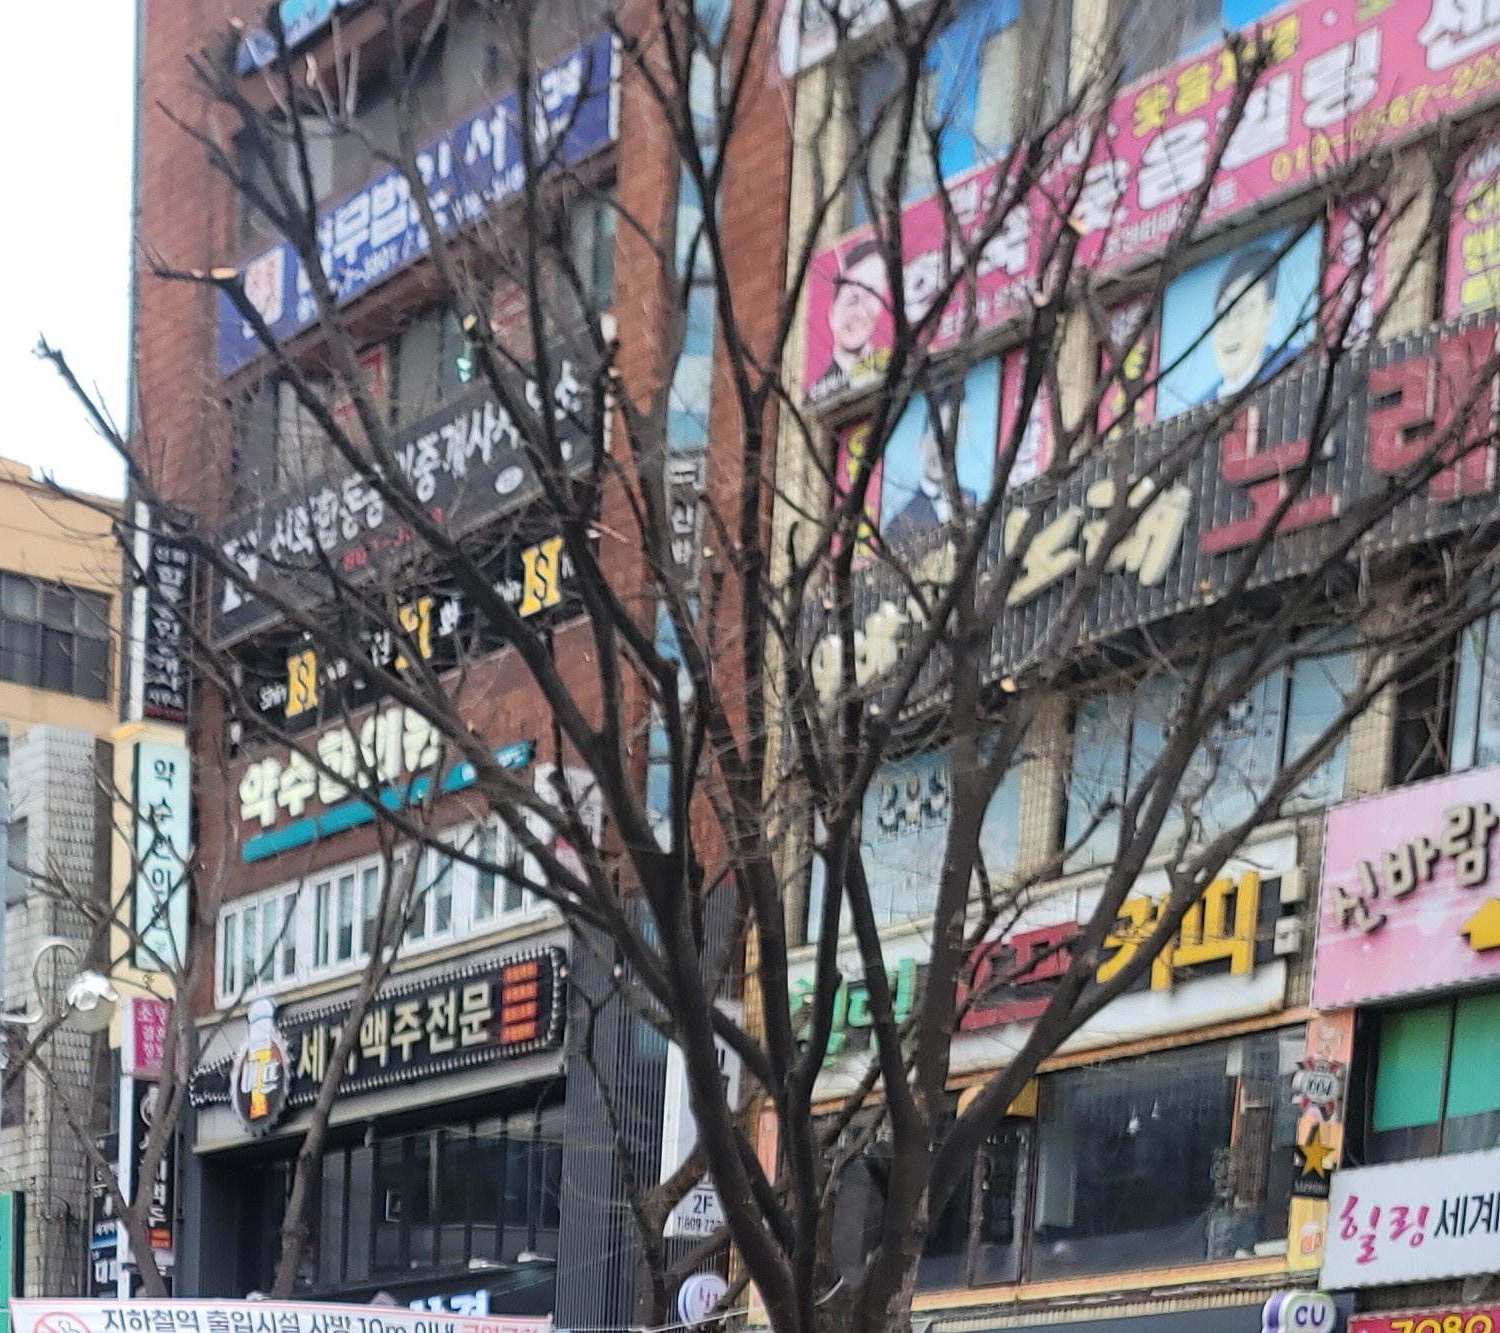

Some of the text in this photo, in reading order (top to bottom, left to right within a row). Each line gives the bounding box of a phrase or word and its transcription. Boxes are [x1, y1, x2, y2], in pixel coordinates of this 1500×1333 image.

[1331, 802, 1498, 933] 신바람
[693, 1194, 713, 1215] 2F
[1339, 1192, 1430, 1265] 힐링
[102, 1308, 200, 1333] 지하철역
[1294, 1303, 1326, 1329] CU
